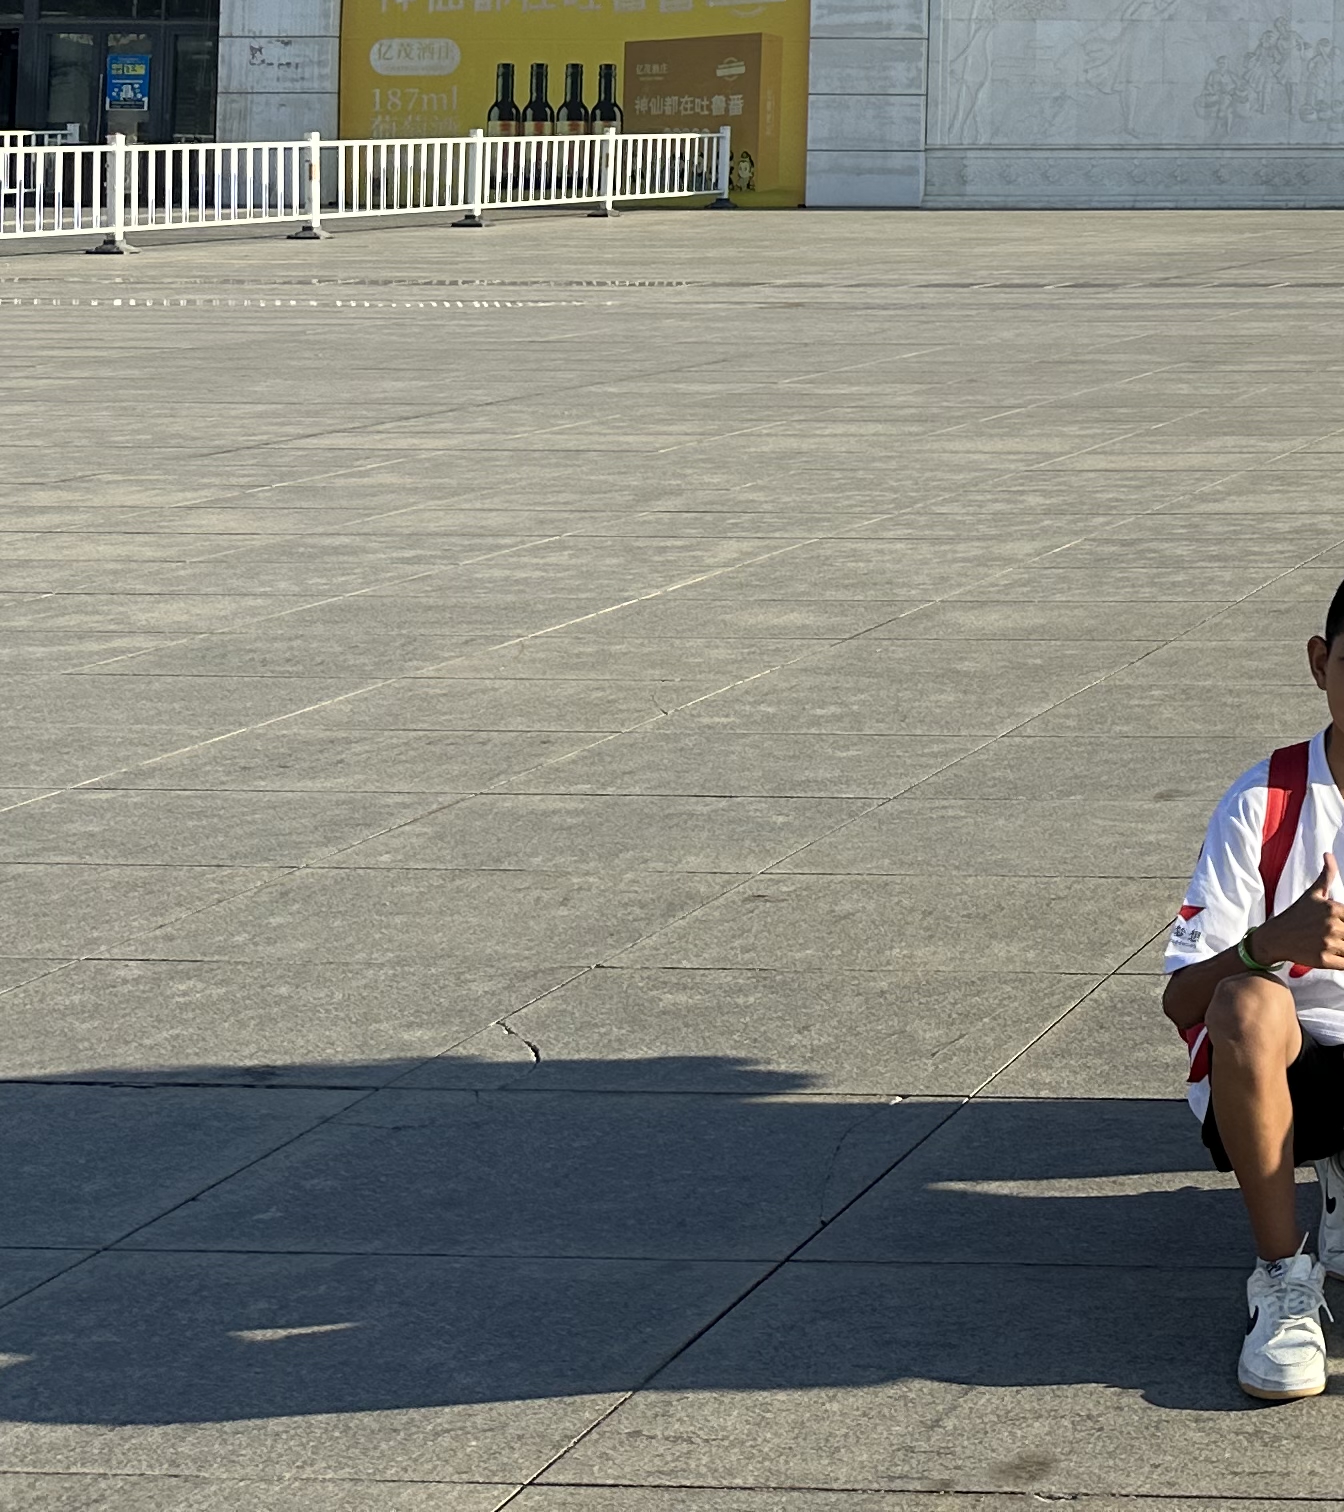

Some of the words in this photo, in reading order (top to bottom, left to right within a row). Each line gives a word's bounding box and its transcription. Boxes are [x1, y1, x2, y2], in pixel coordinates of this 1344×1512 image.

[373, 85, 457, 112] 187ml
[634, 94, 744, 117] 神仙都在吐鲁番
